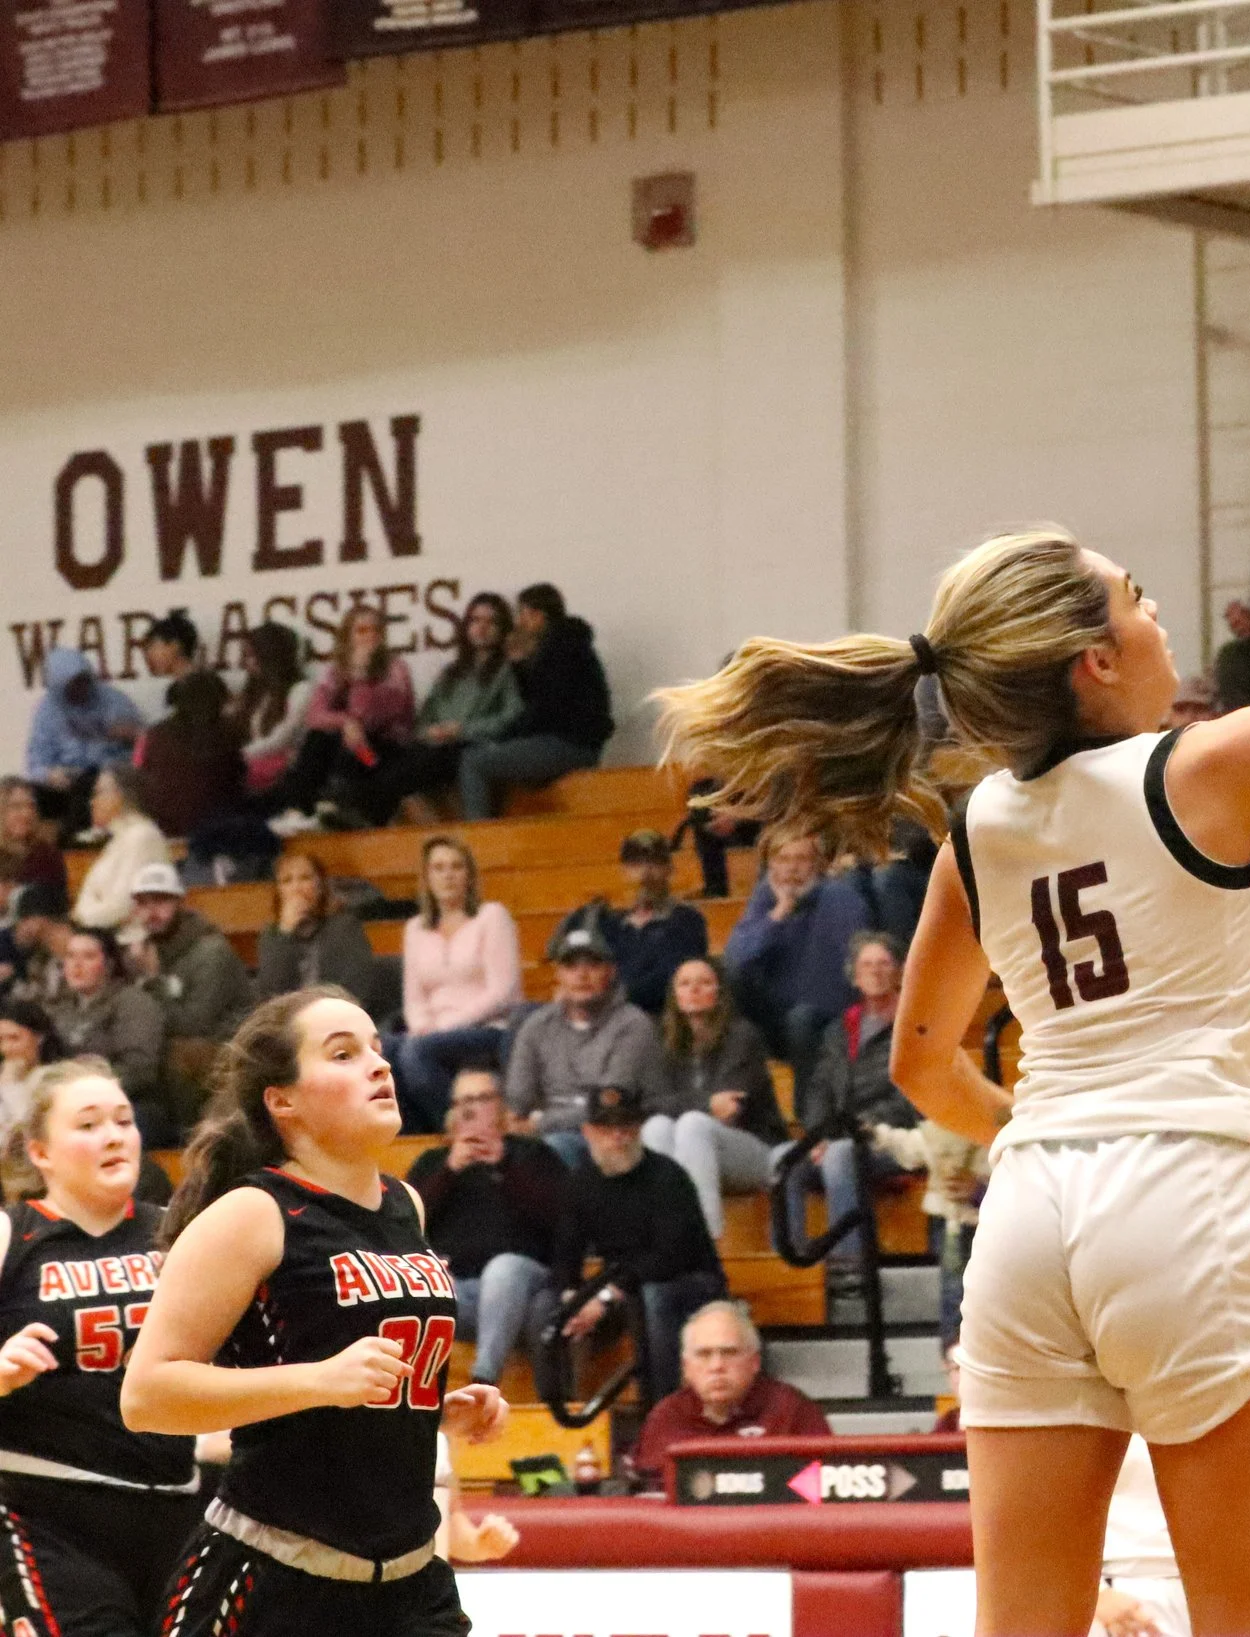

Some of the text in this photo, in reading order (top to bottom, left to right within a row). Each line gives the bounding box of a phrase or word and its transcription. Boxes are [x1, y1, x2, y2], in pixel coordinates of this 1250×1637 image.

[54, 414, 421, 590] OWEN
[1030, 860, 1130, 1011] 15
[328, 1249, 457, 1307] AVER
[74, 1302, 152, 1372] 5
[819, 1464, 886, 1498] POSS
